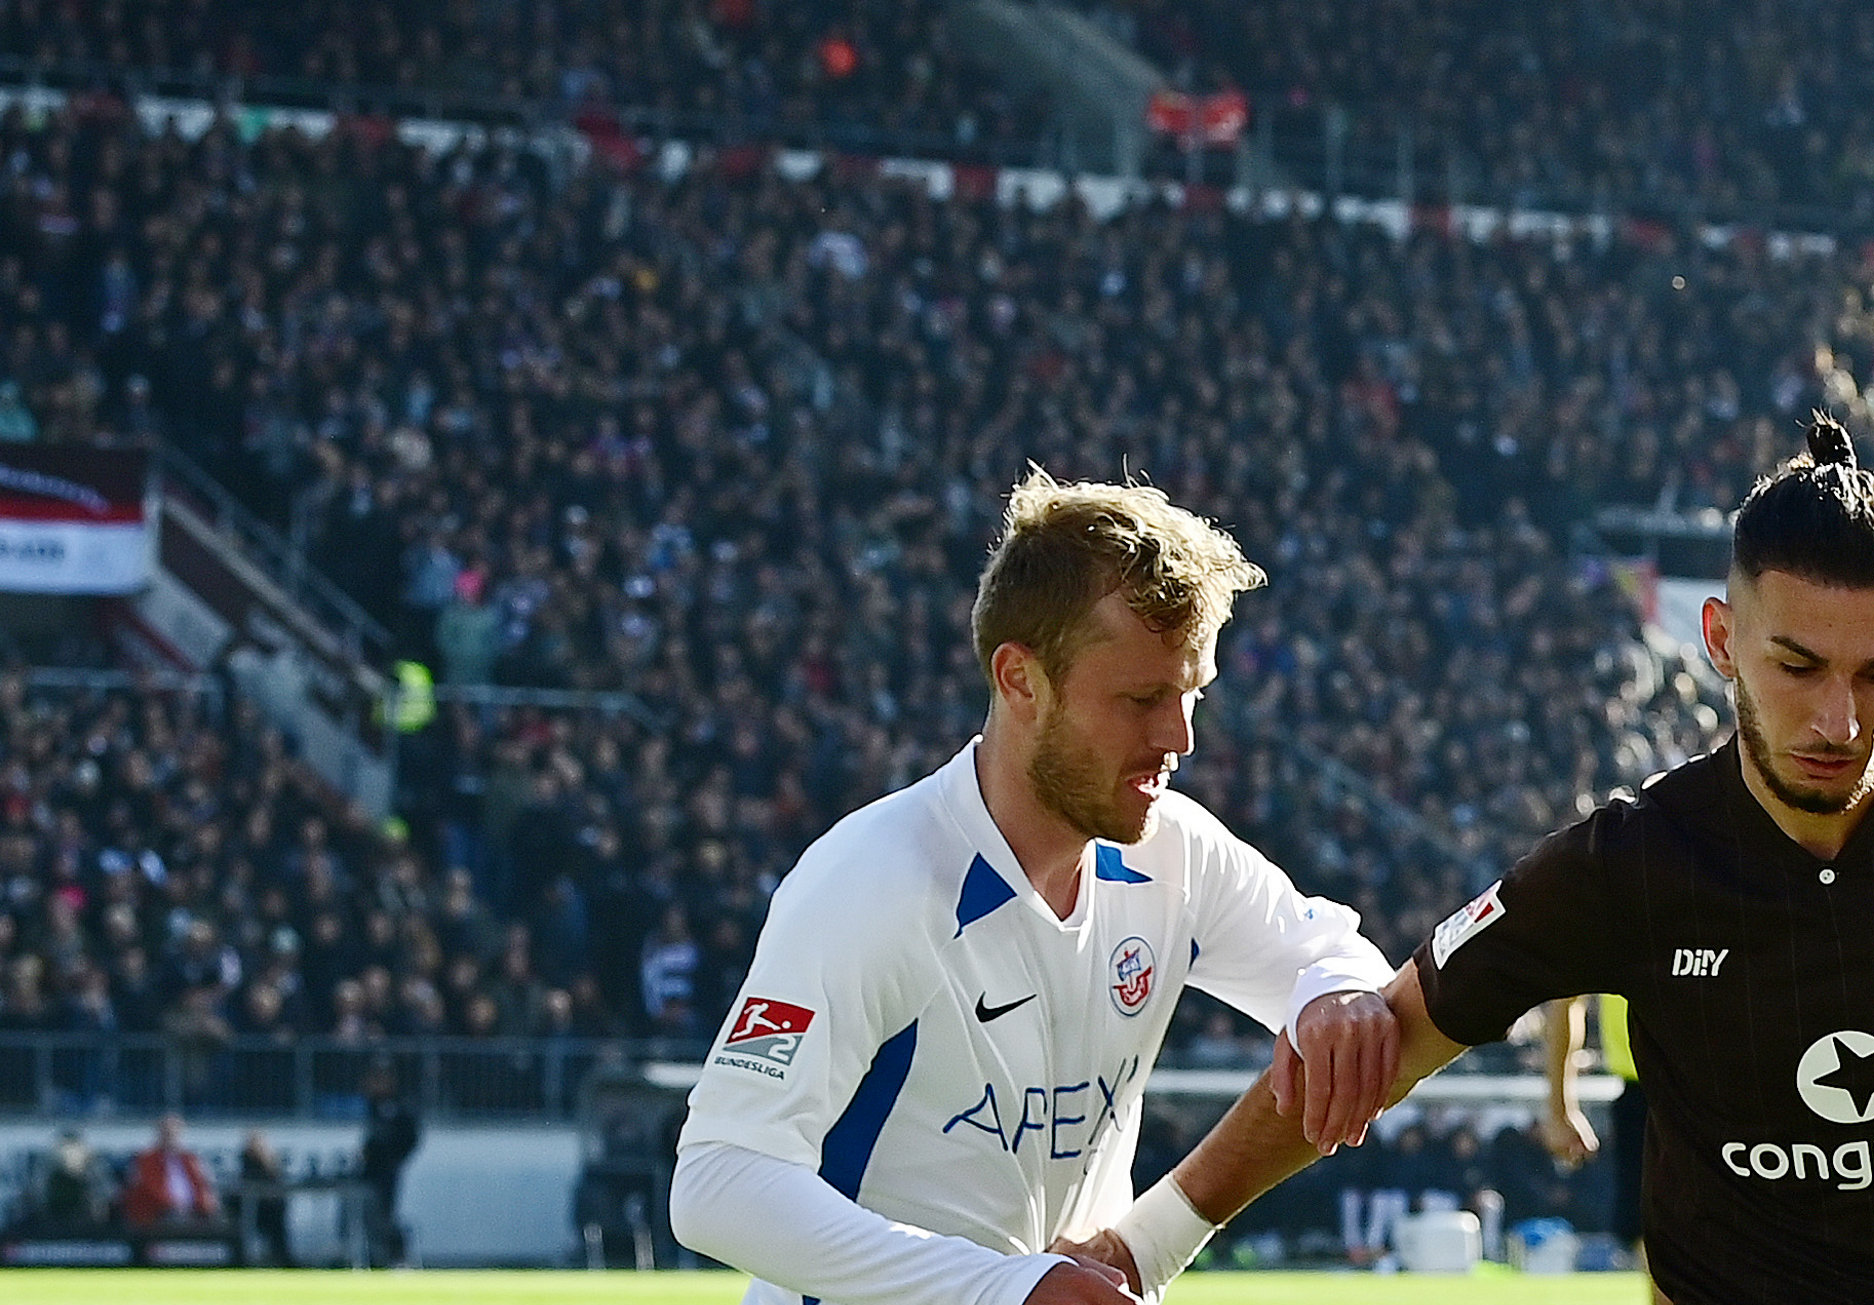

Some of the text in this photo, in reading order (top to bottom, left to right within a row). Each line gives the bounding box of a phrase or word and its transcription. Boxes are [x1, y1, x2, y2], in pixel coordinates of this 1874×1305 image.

[767, 1034, 798, 1062] 2
[714, 1056, 785, 1080] BUNDESLIGA
[942, 1057, 1130, 1160] APEX
